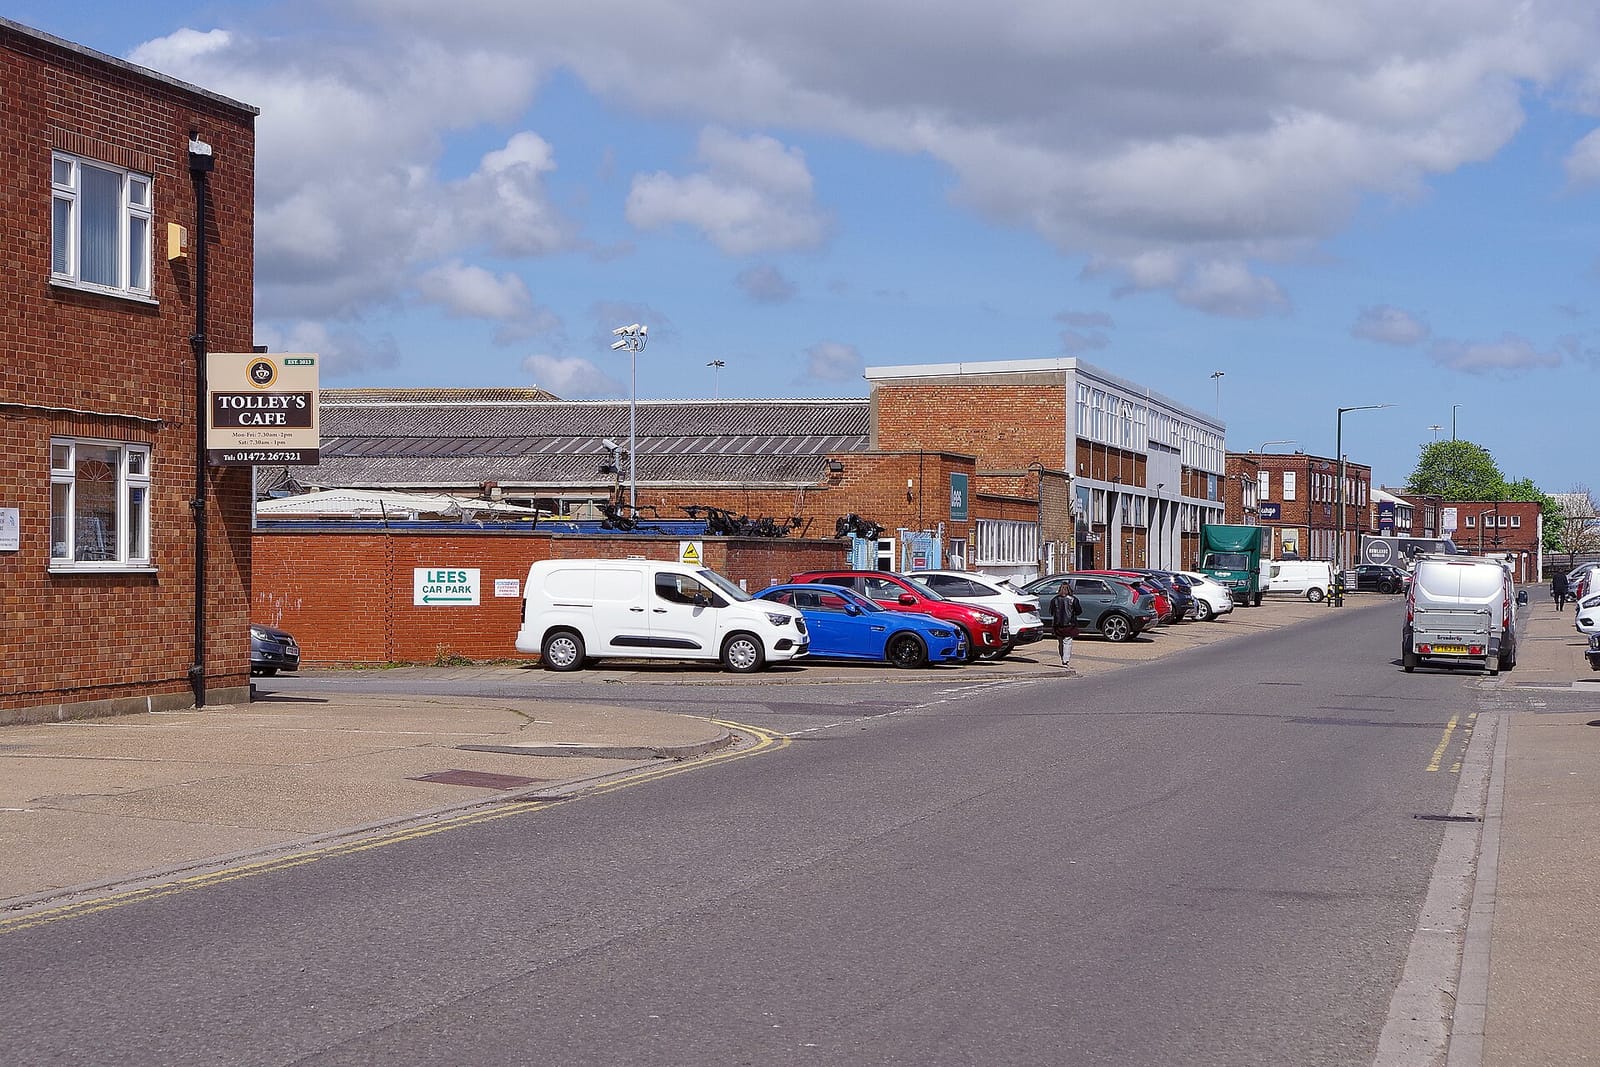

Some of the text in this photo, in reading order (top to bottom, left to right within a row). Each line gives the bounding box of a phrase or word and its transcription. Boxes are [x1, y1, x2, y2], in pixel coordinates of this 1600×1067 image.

[218, 395, 306, 409] TOLLEY'S
[238, 412, 287, 426] CAFE
[236, 452, 266, 461] 01472
[267, 452, 301, 461] 267321
[427, 570, 467, 583] LEES
[422, 585, 472, 594] CAR PARK
